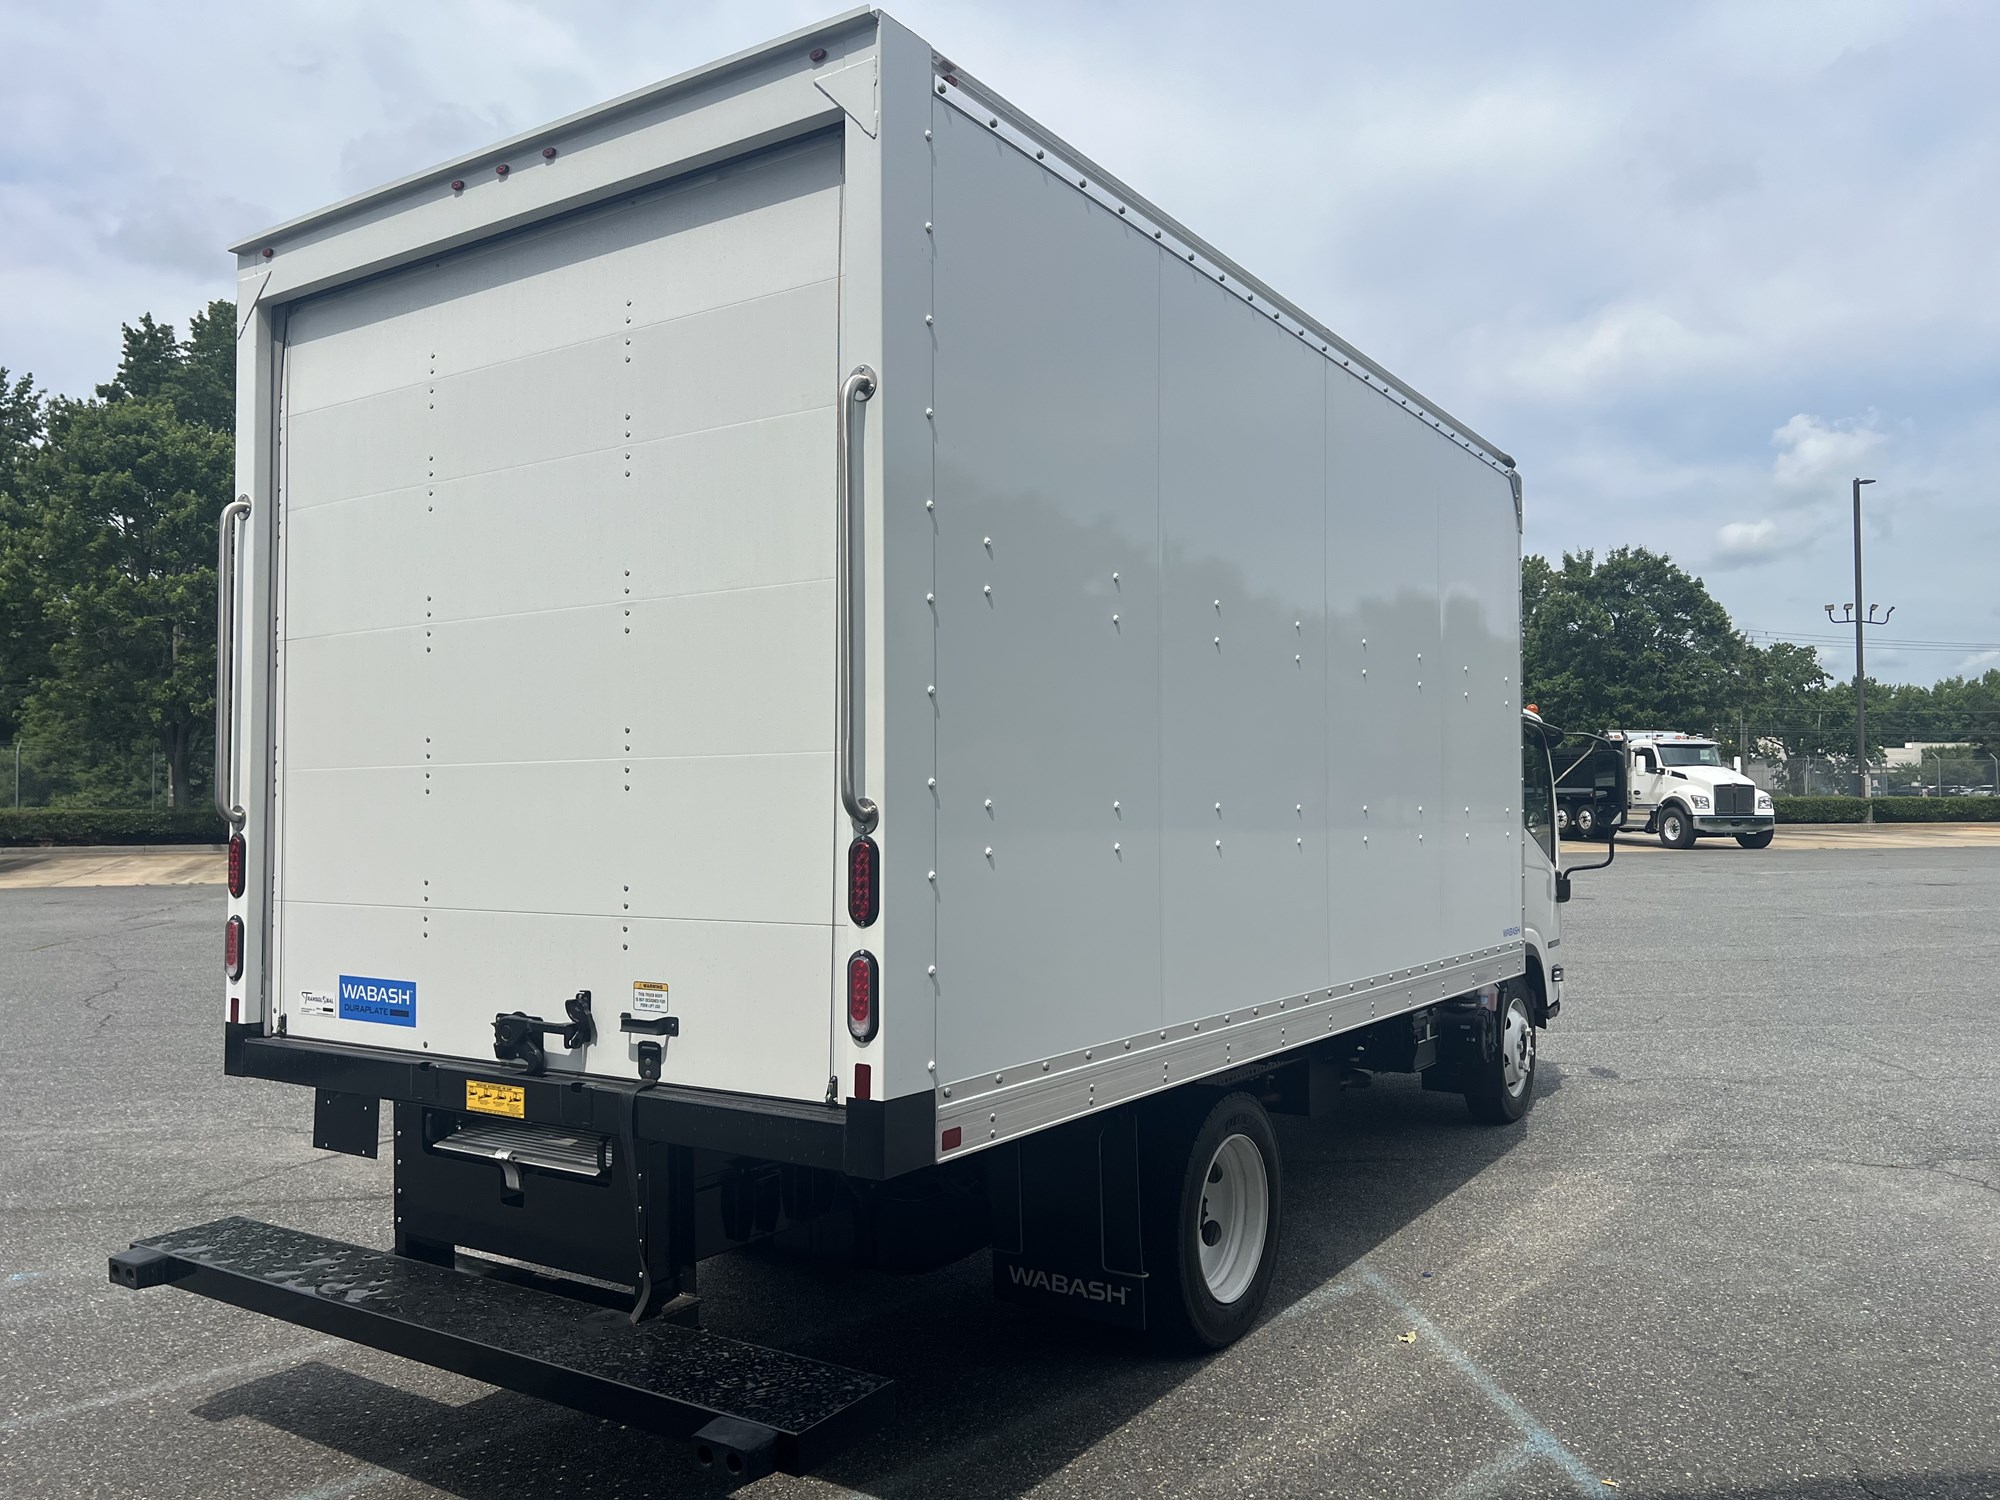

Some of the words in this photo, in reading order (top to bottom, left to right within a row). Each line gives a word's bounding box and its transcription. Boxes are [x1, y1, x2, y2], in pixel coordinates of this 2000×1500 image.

[1503, 926, 1520, 937] WABASH
[342, 983, 410, 1005] WABASH
[344, 1004, 388, 1016] DURAPLATE
[1009, 1264, 1126, 1306] WABASH
